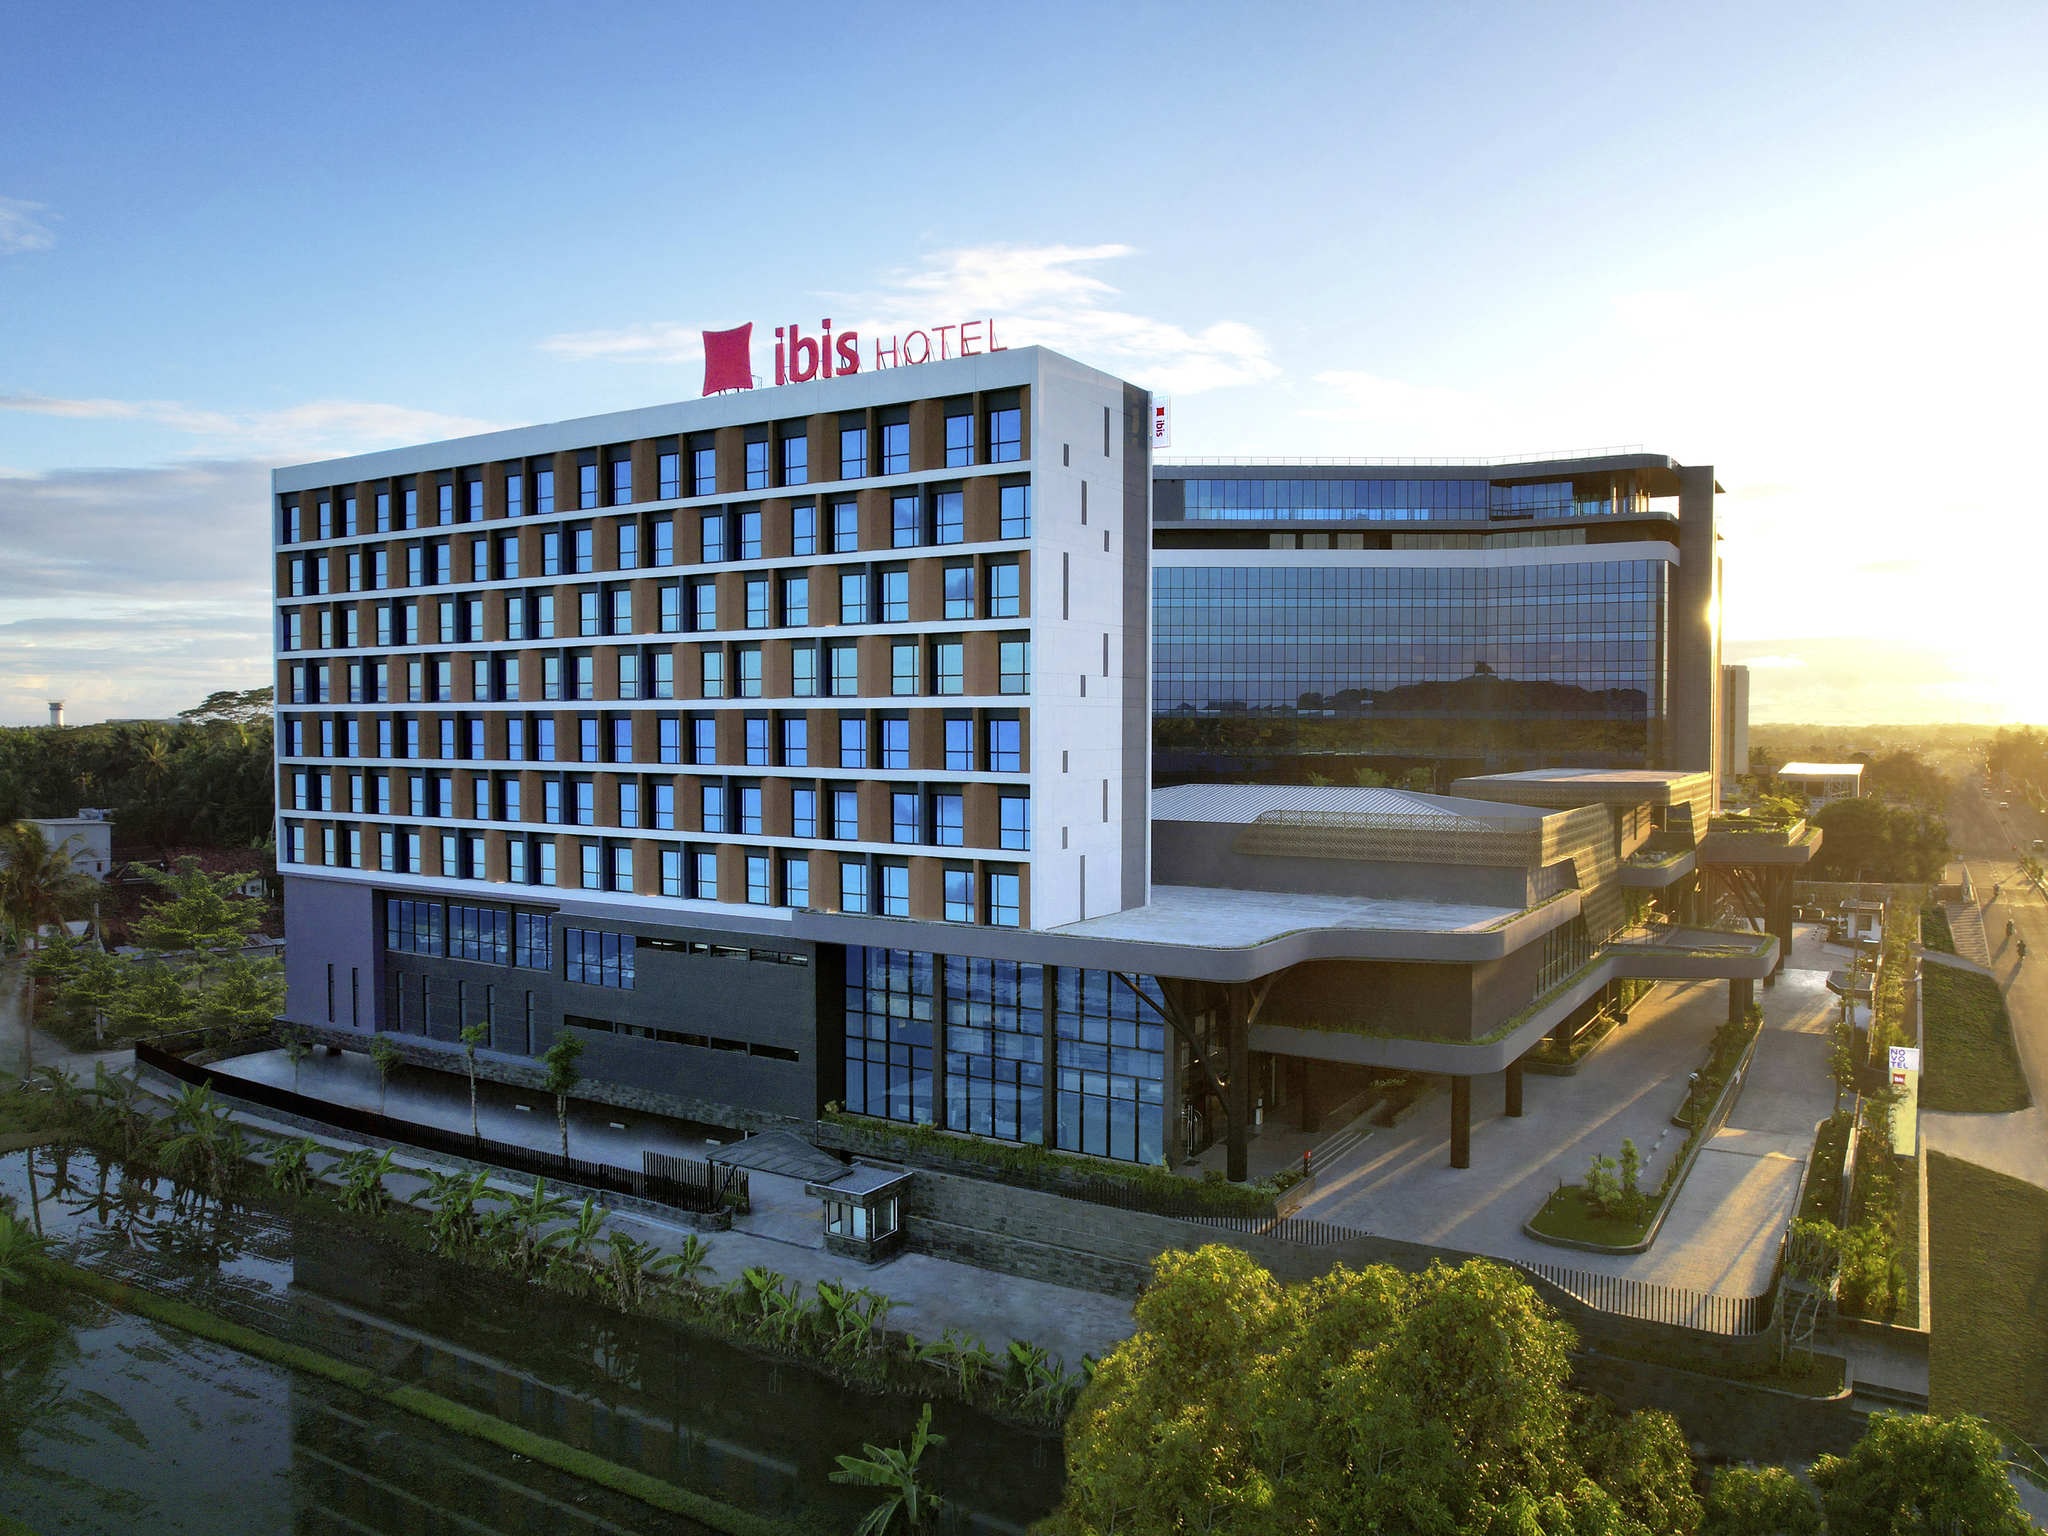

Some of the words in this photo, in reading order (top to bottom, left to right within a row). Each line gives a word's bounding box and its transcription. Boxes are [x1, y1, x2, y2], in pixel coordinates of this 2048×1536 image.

[775, 318, 860, 385] ibis
[876, 318, 1008, 370] HOTEL
[1156, 420, 1165, 437] ibis
